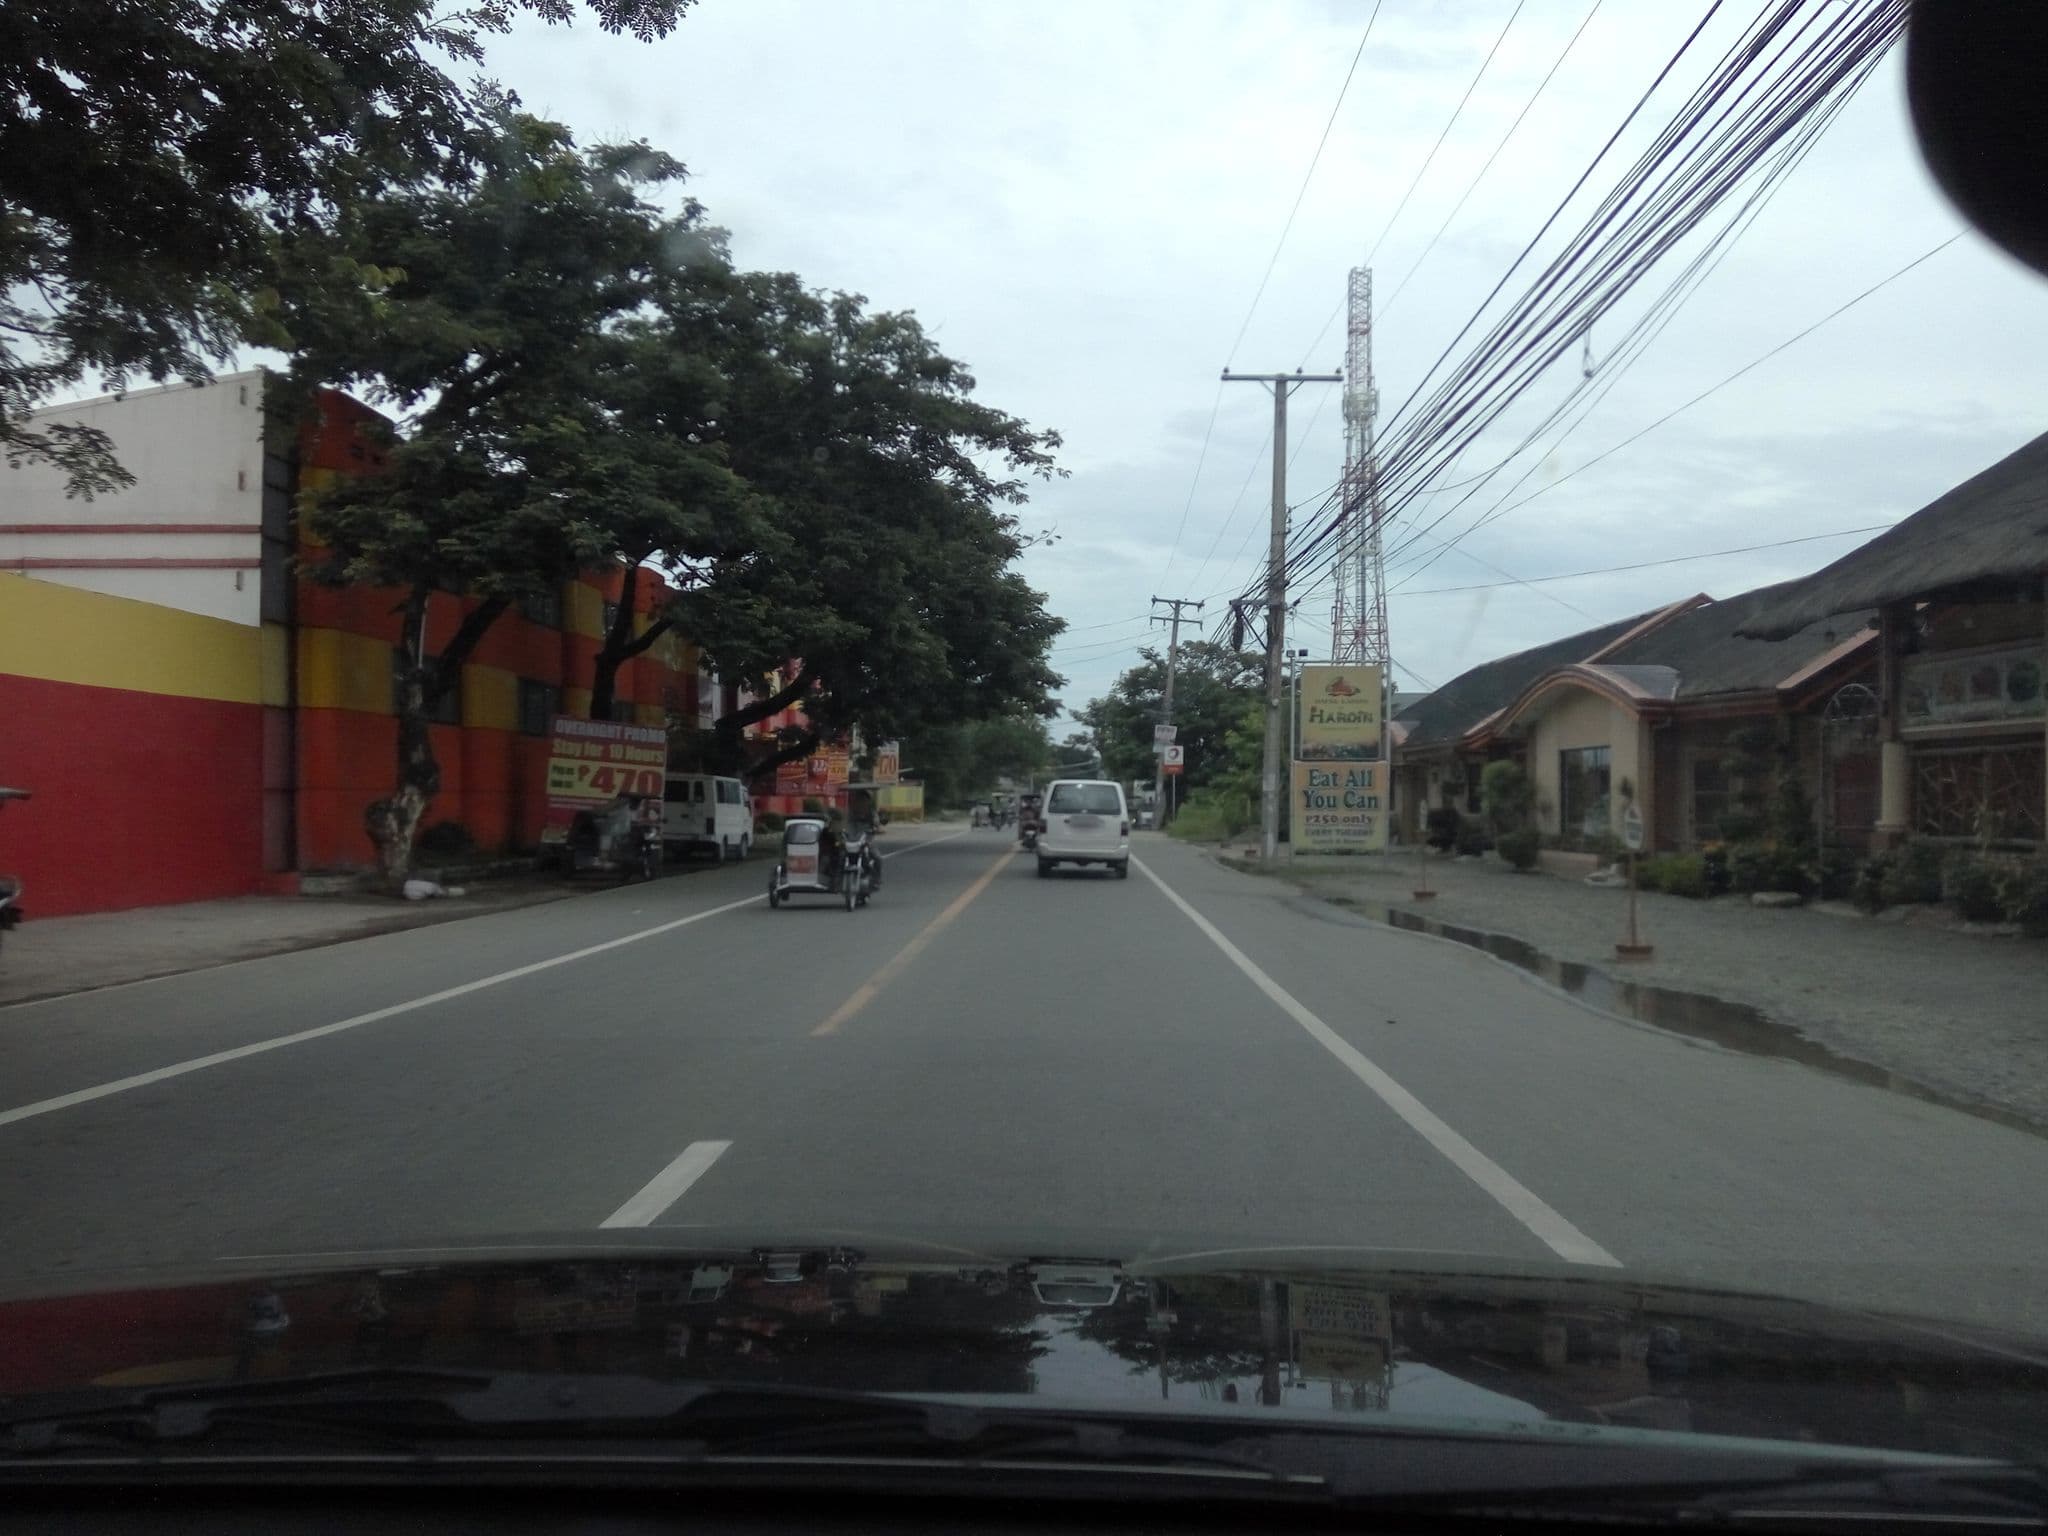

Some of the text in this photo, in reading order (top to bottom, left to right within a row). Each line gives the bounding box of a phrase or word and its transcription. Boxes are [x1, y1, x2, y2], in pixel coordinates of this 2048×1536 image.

[625, 746, 664, 763] Hours
[1309, 768, 1373, 787] Eat All
[1303, 789, 1378, 809] You Can
[1343, 814, 1373, 825] only
